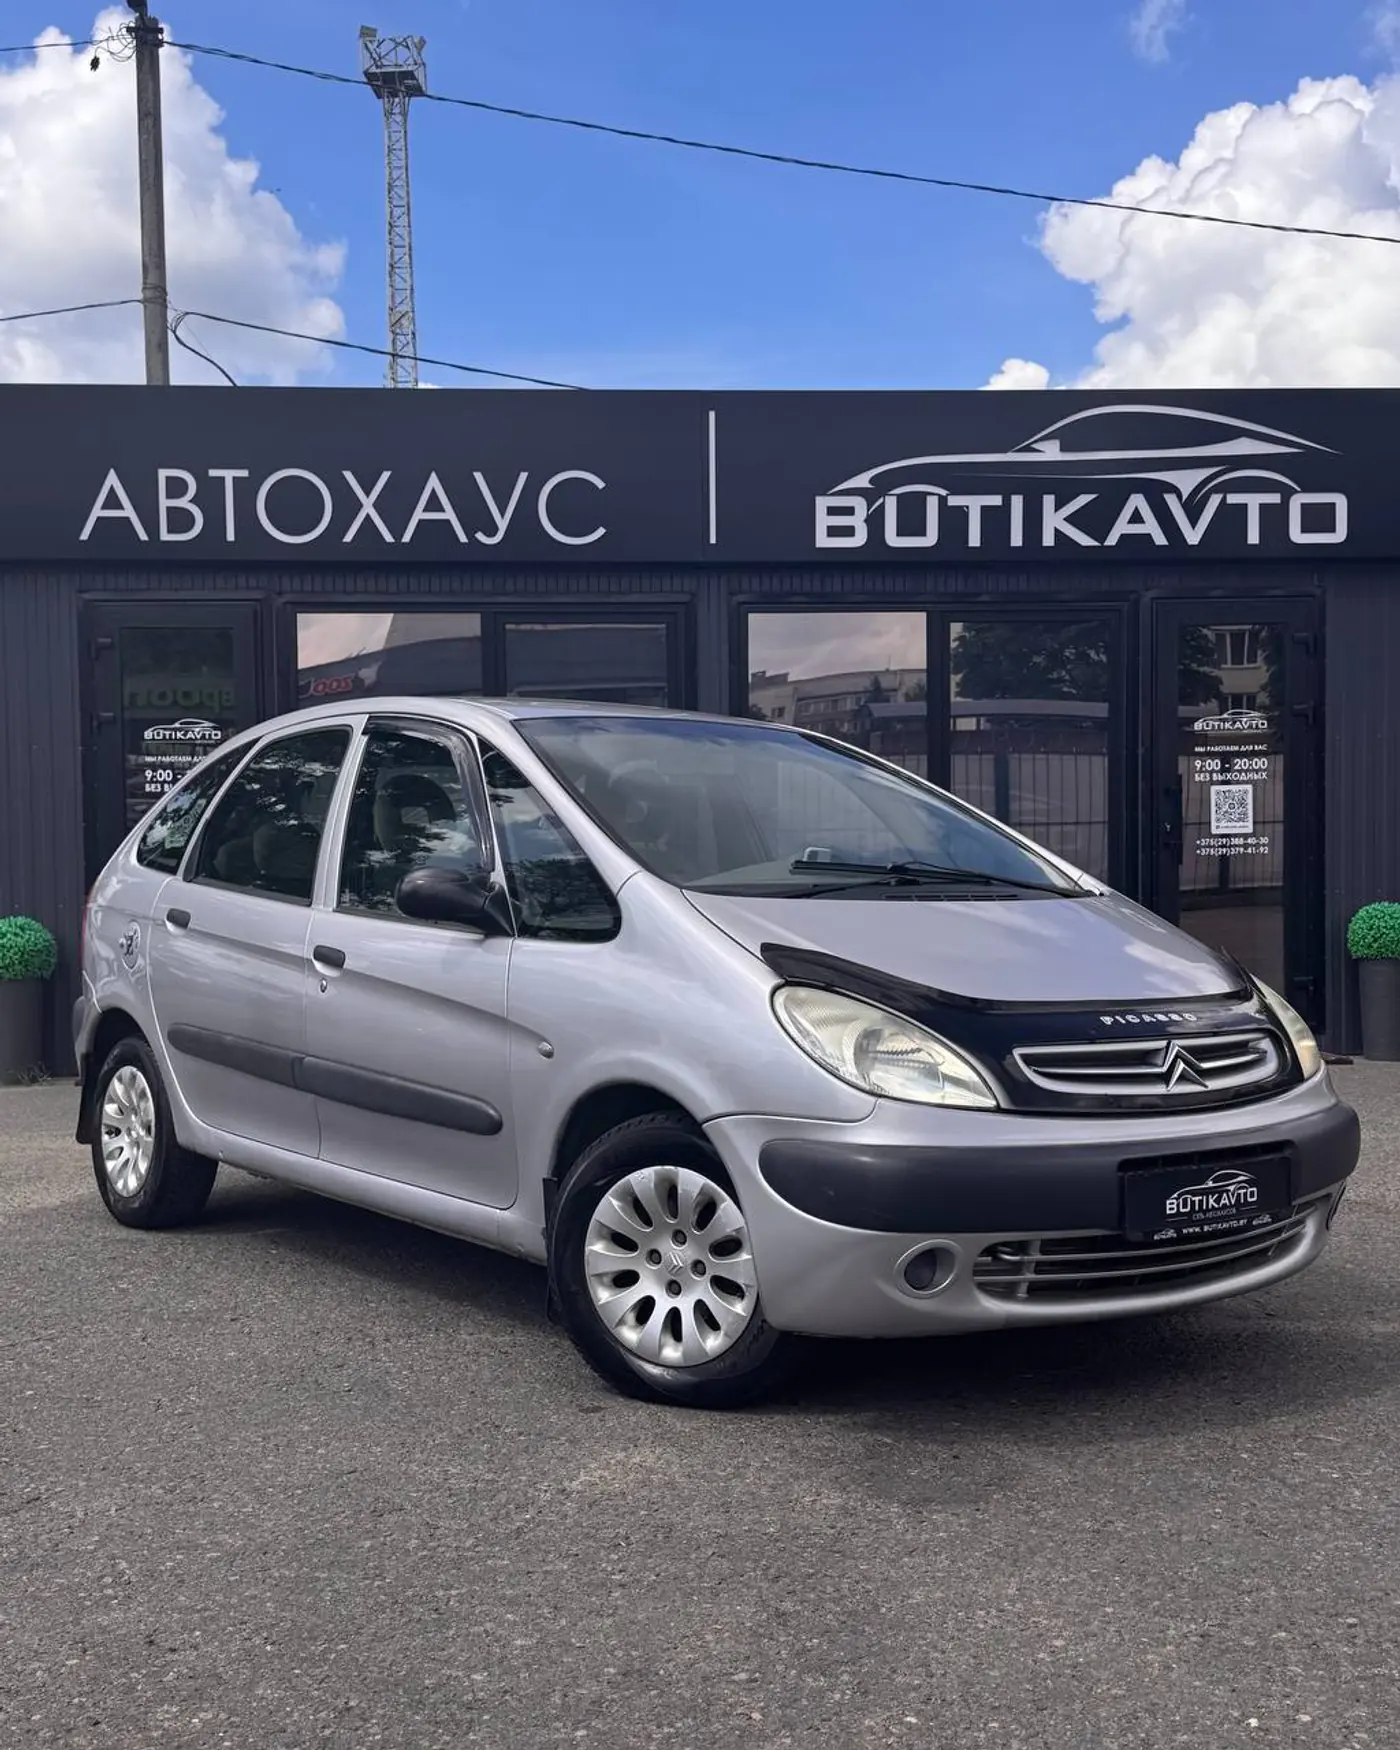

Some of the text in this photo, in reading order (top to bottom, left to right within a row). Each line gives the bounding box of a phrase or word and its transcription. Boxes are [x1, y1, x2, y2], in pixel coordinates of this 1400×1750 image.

[79, 468, 607, 546] АВТОХАУС
[815, 492, 1348, 548] BUTIKAVTO
[1194, 720, 1268, 730] BUTIKAVTO
[144, 730, 221, 740] BUTIKAVTO
[1194, 759, 1221, 771] 9:00
[1234, 758, 1268, 770] 20:00
[145, 769, 173, 781] 9:00
[1194, 771, 1268, 782] БЕЗ ВЫХОДНЫХ
[144, 783, 161, 792] БЕЗ
[1100, 1013, 1198, 1025] PICASSO
[1166, 1187, 1258, 1214] BUTIKAVTO
